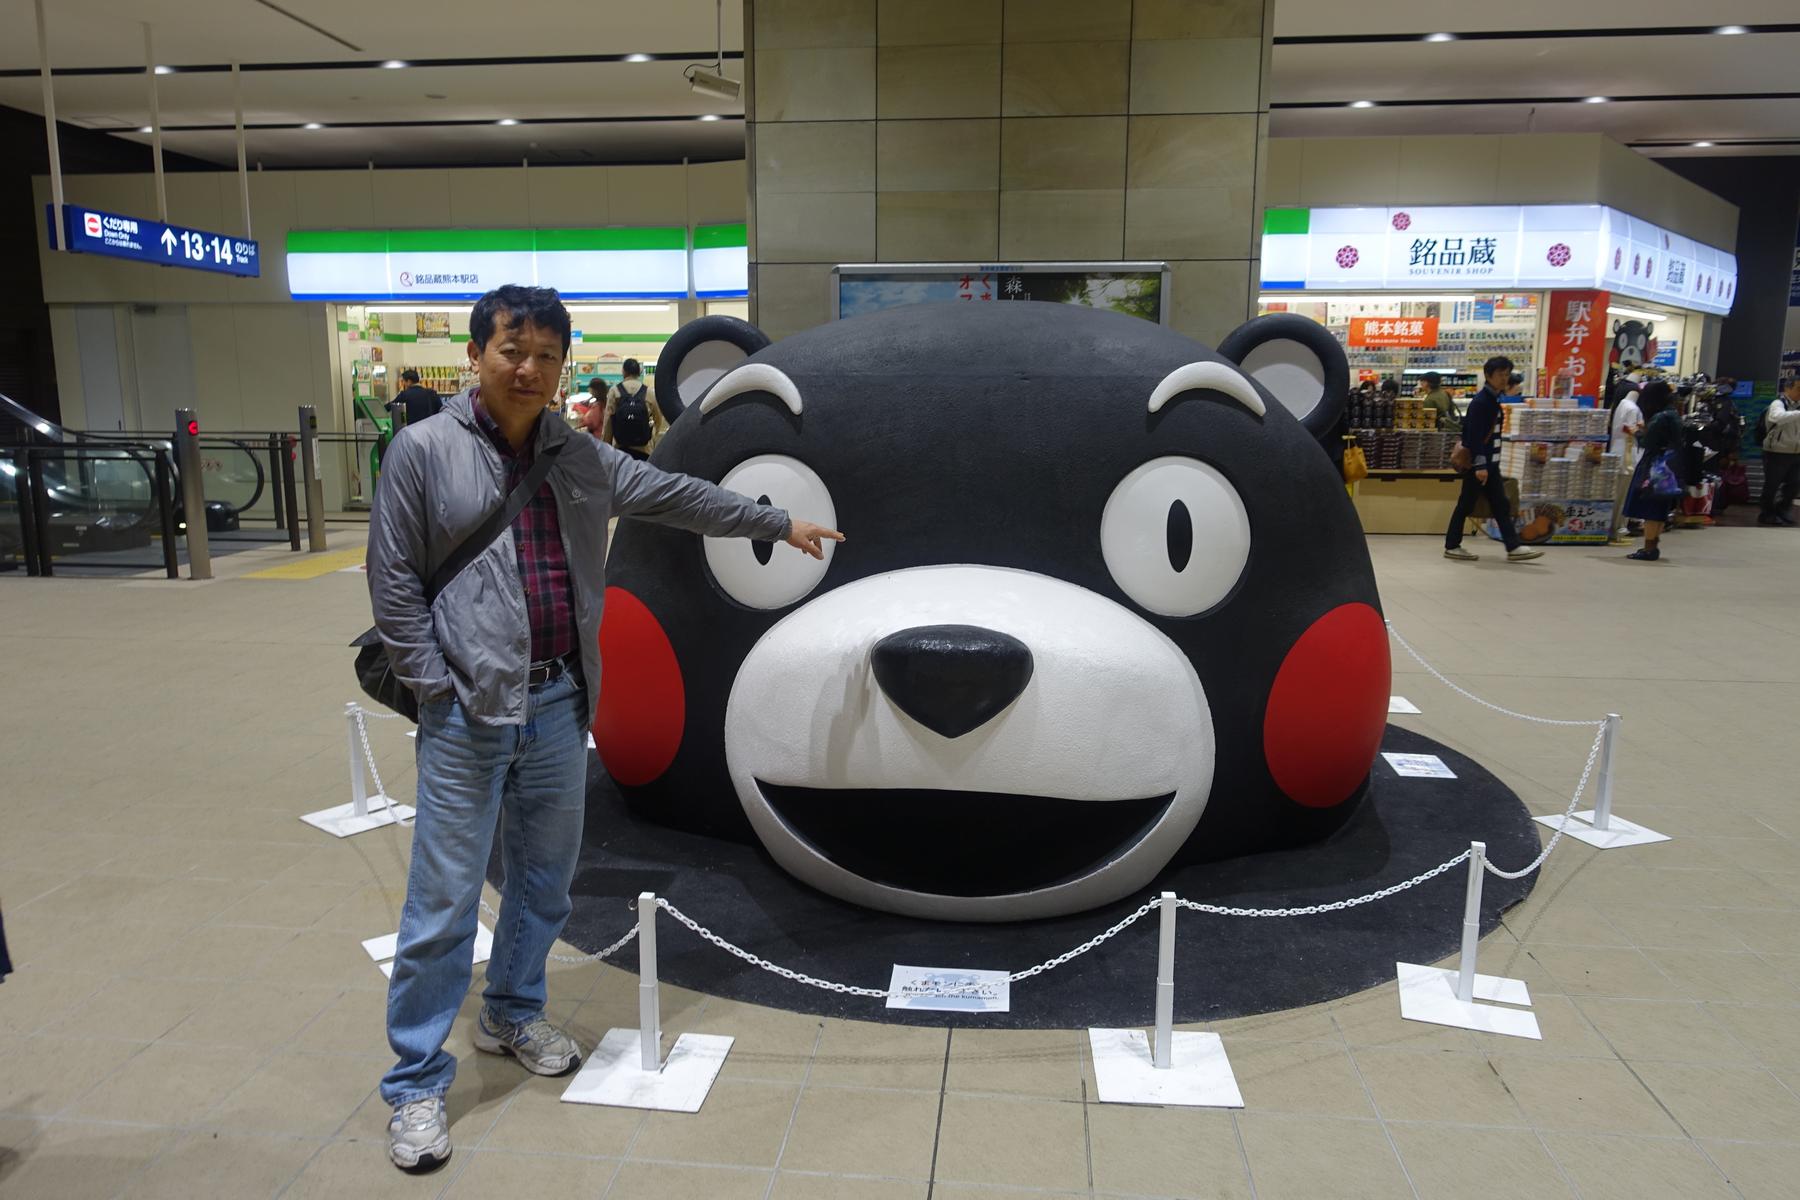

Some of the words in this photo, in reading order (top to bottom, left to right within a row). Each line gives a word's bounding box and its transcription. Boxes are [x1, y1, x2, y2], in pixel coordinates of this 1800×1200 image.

[235, 241, 256, 257] のりば
[1409, 237, 1497, 266] 銘品蔵
[415, 273, 479, 285] 銘品蔵熊本駅店
[1466, 267, 1494, 275] SHOP
[1363, 320, 1424, 337] 熊本銘菓
